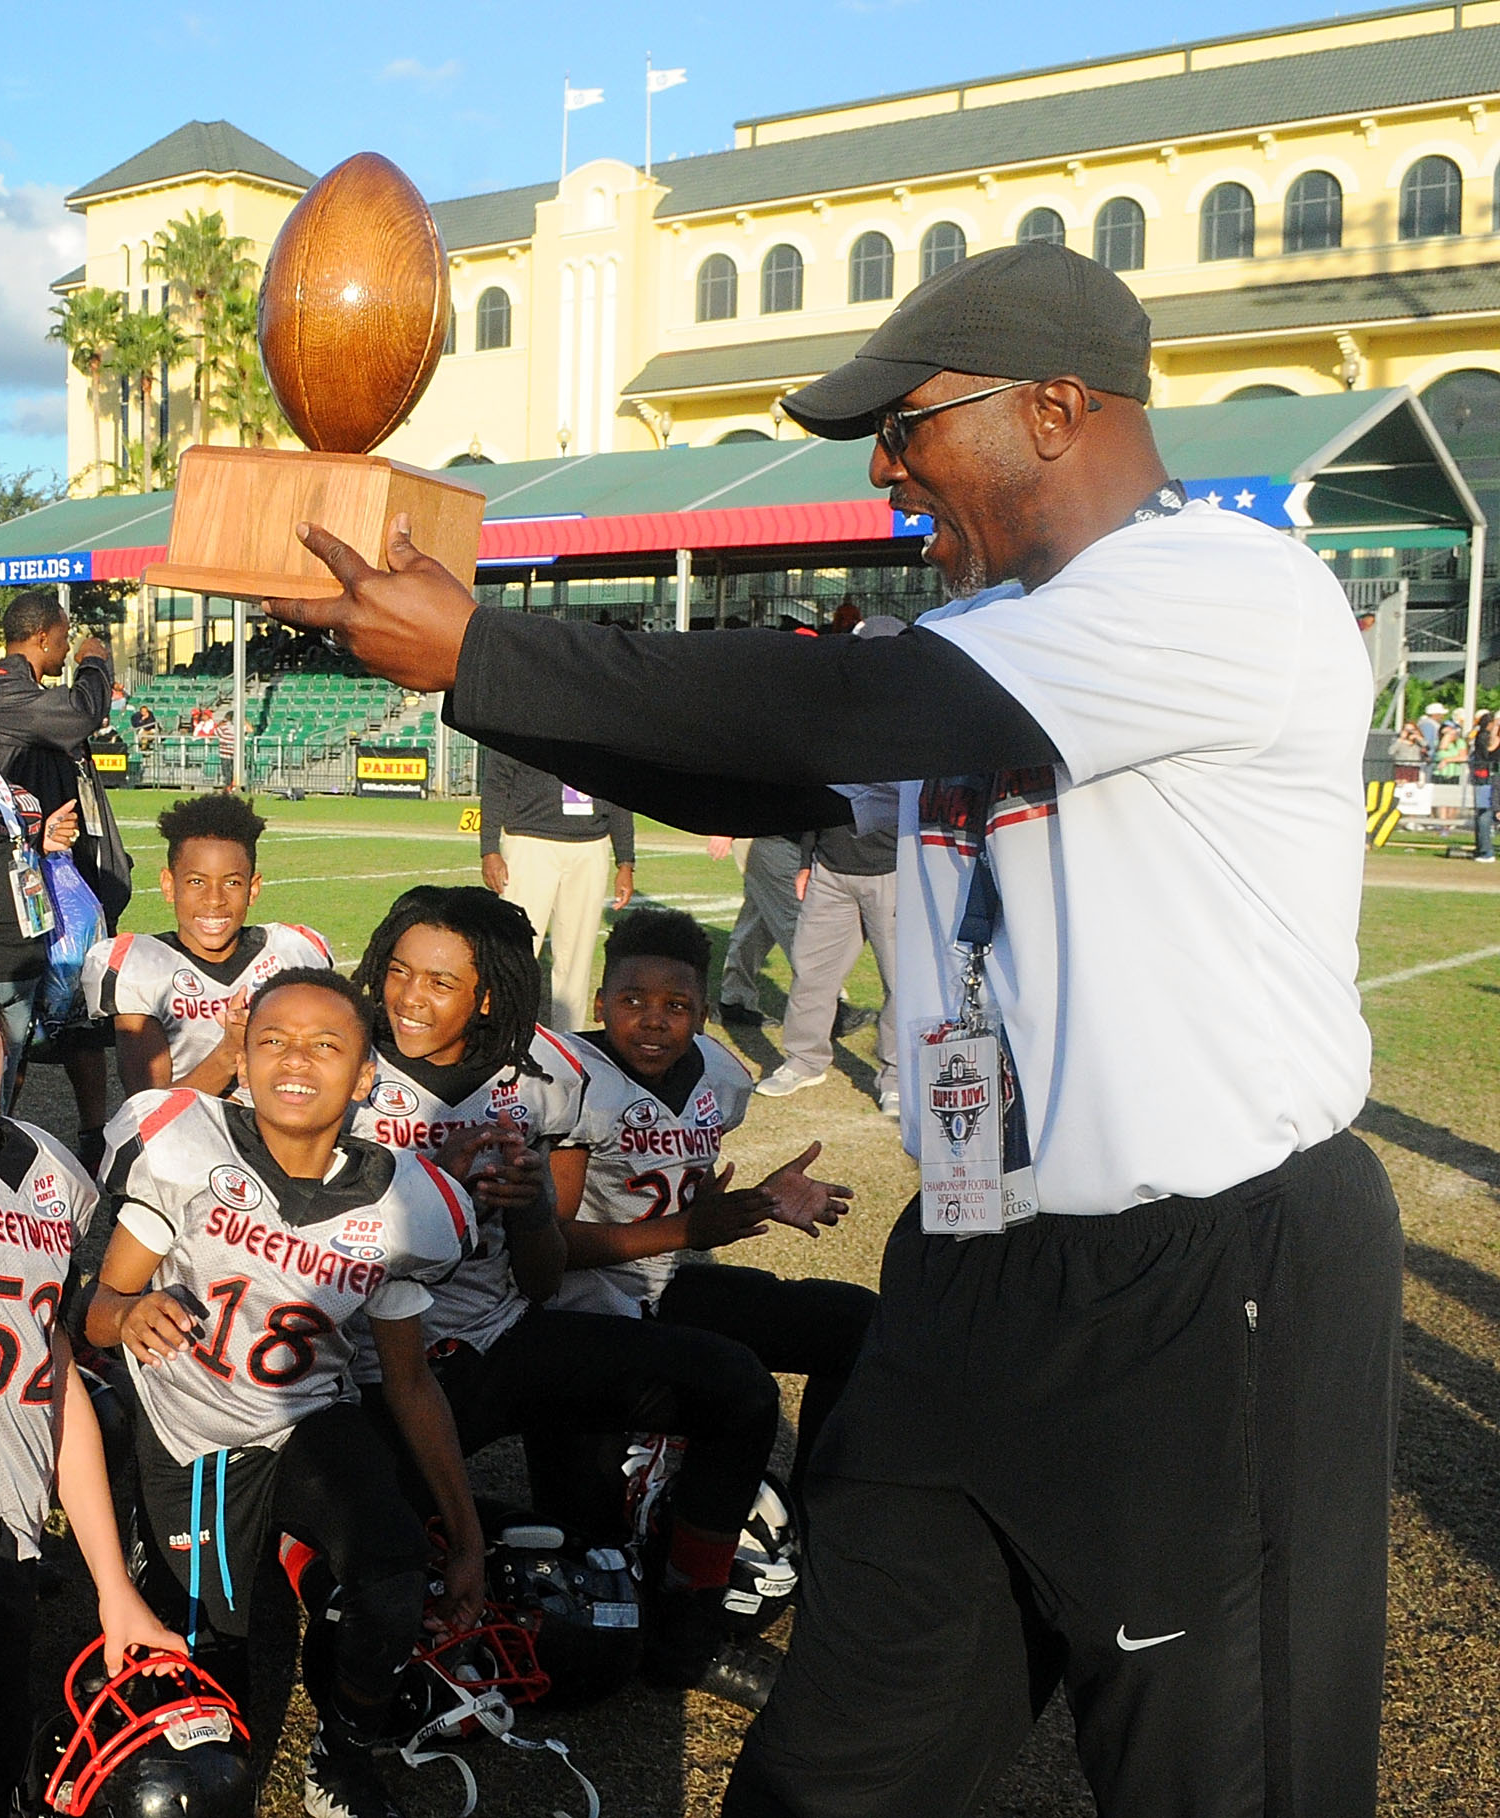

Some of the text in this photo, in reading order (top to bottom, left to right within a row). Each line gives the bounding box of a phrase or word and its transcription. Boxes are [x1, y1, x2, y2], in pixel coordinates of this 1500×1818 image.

[9, 558, 70, 581] FIELDS
[362, 762, 421, 775] PANINI
[460, 810, 481, 832] 30
[254, 955, 277, 974] POP
[696, 1091, 713, 1110] POP
[933, 1085, 986, 1108] SUPER BOWL
[34, 1175, 54, 1192] POP
[923, 1179, 998, 1192] CHAMPIONSHIP FOOTBALL
[1004, 1200, 1032, 1216] CCESS
[344, 1219, 383, 1232] POP
[341, 1233, 378, 1243] WARNER
[205, 1204, 387, 1297] SWEETWATER
[191, 1275, 335, 1388] 18
[168, 1529, 210, 1546] schtt
